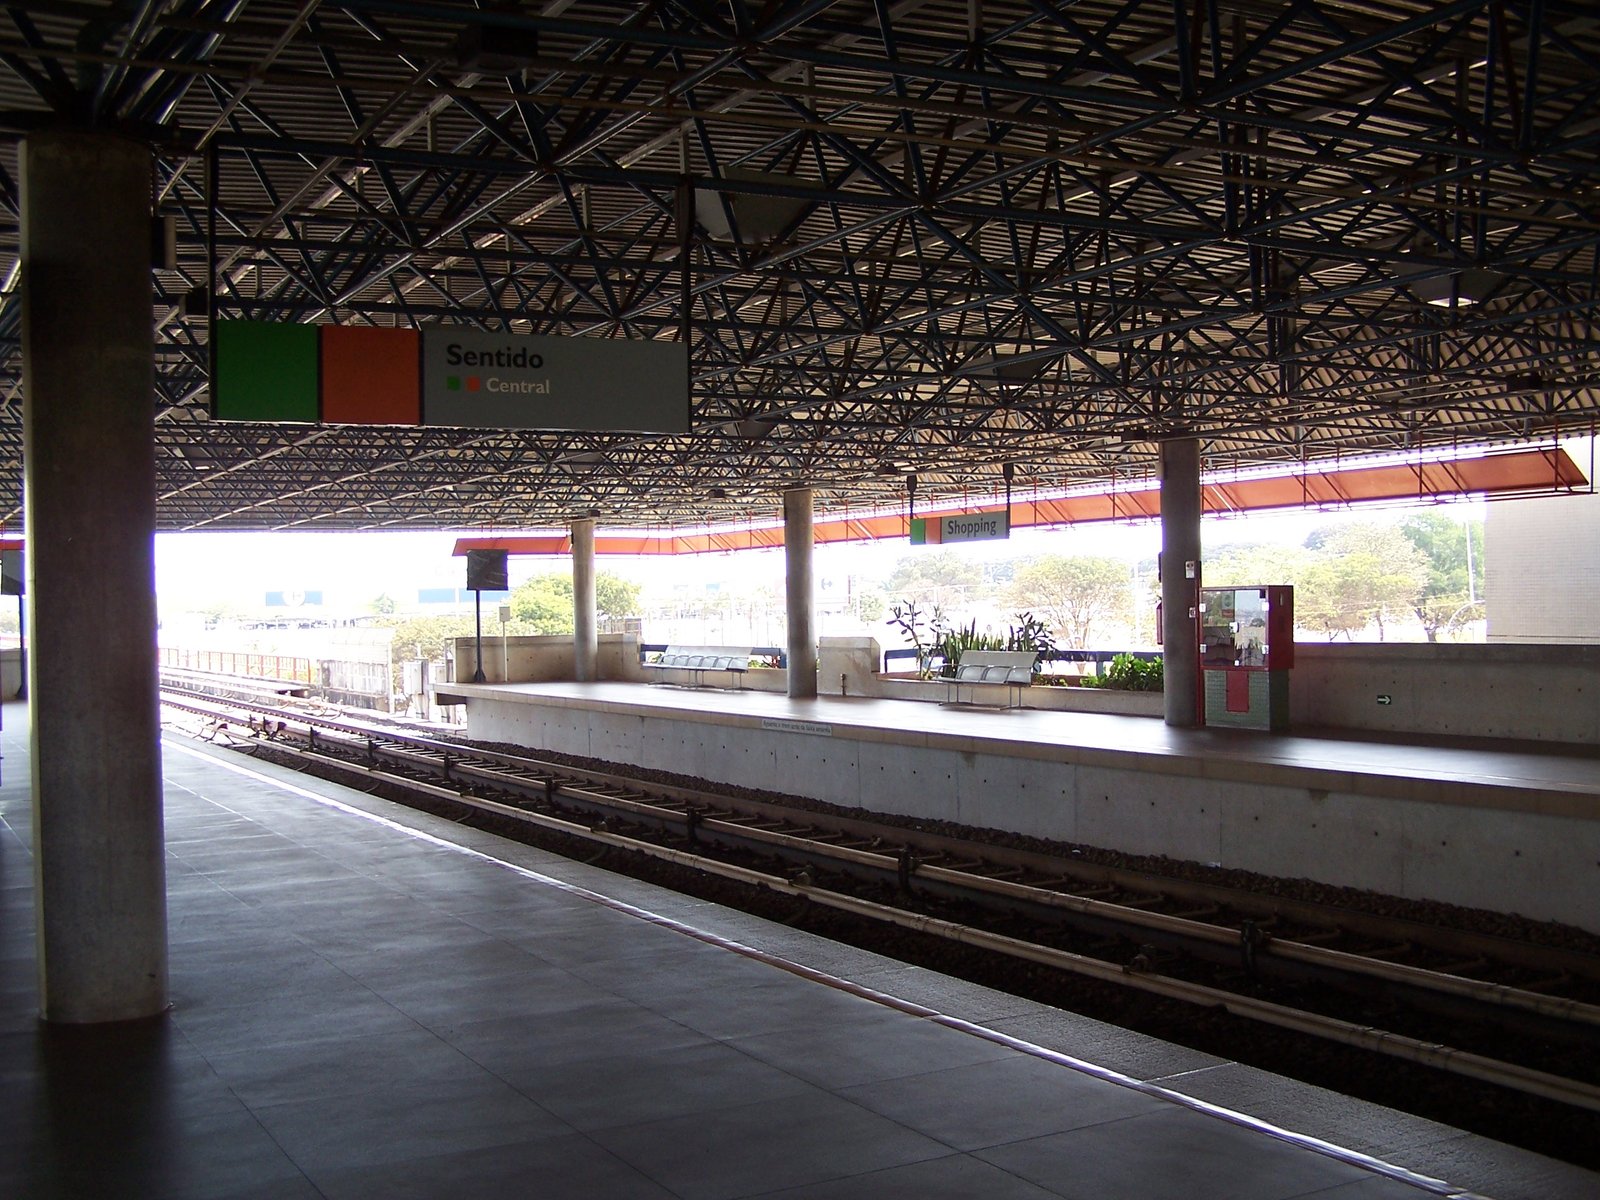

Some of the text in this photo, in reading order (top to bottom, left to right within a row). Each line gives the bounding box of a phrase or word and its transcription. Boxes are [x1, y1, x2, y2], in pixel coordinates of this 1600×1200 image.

[446, 343, 544, 369] Sentido
[485, 377, 550, 394] Central
[947, 517, 997, 538] Shopping
